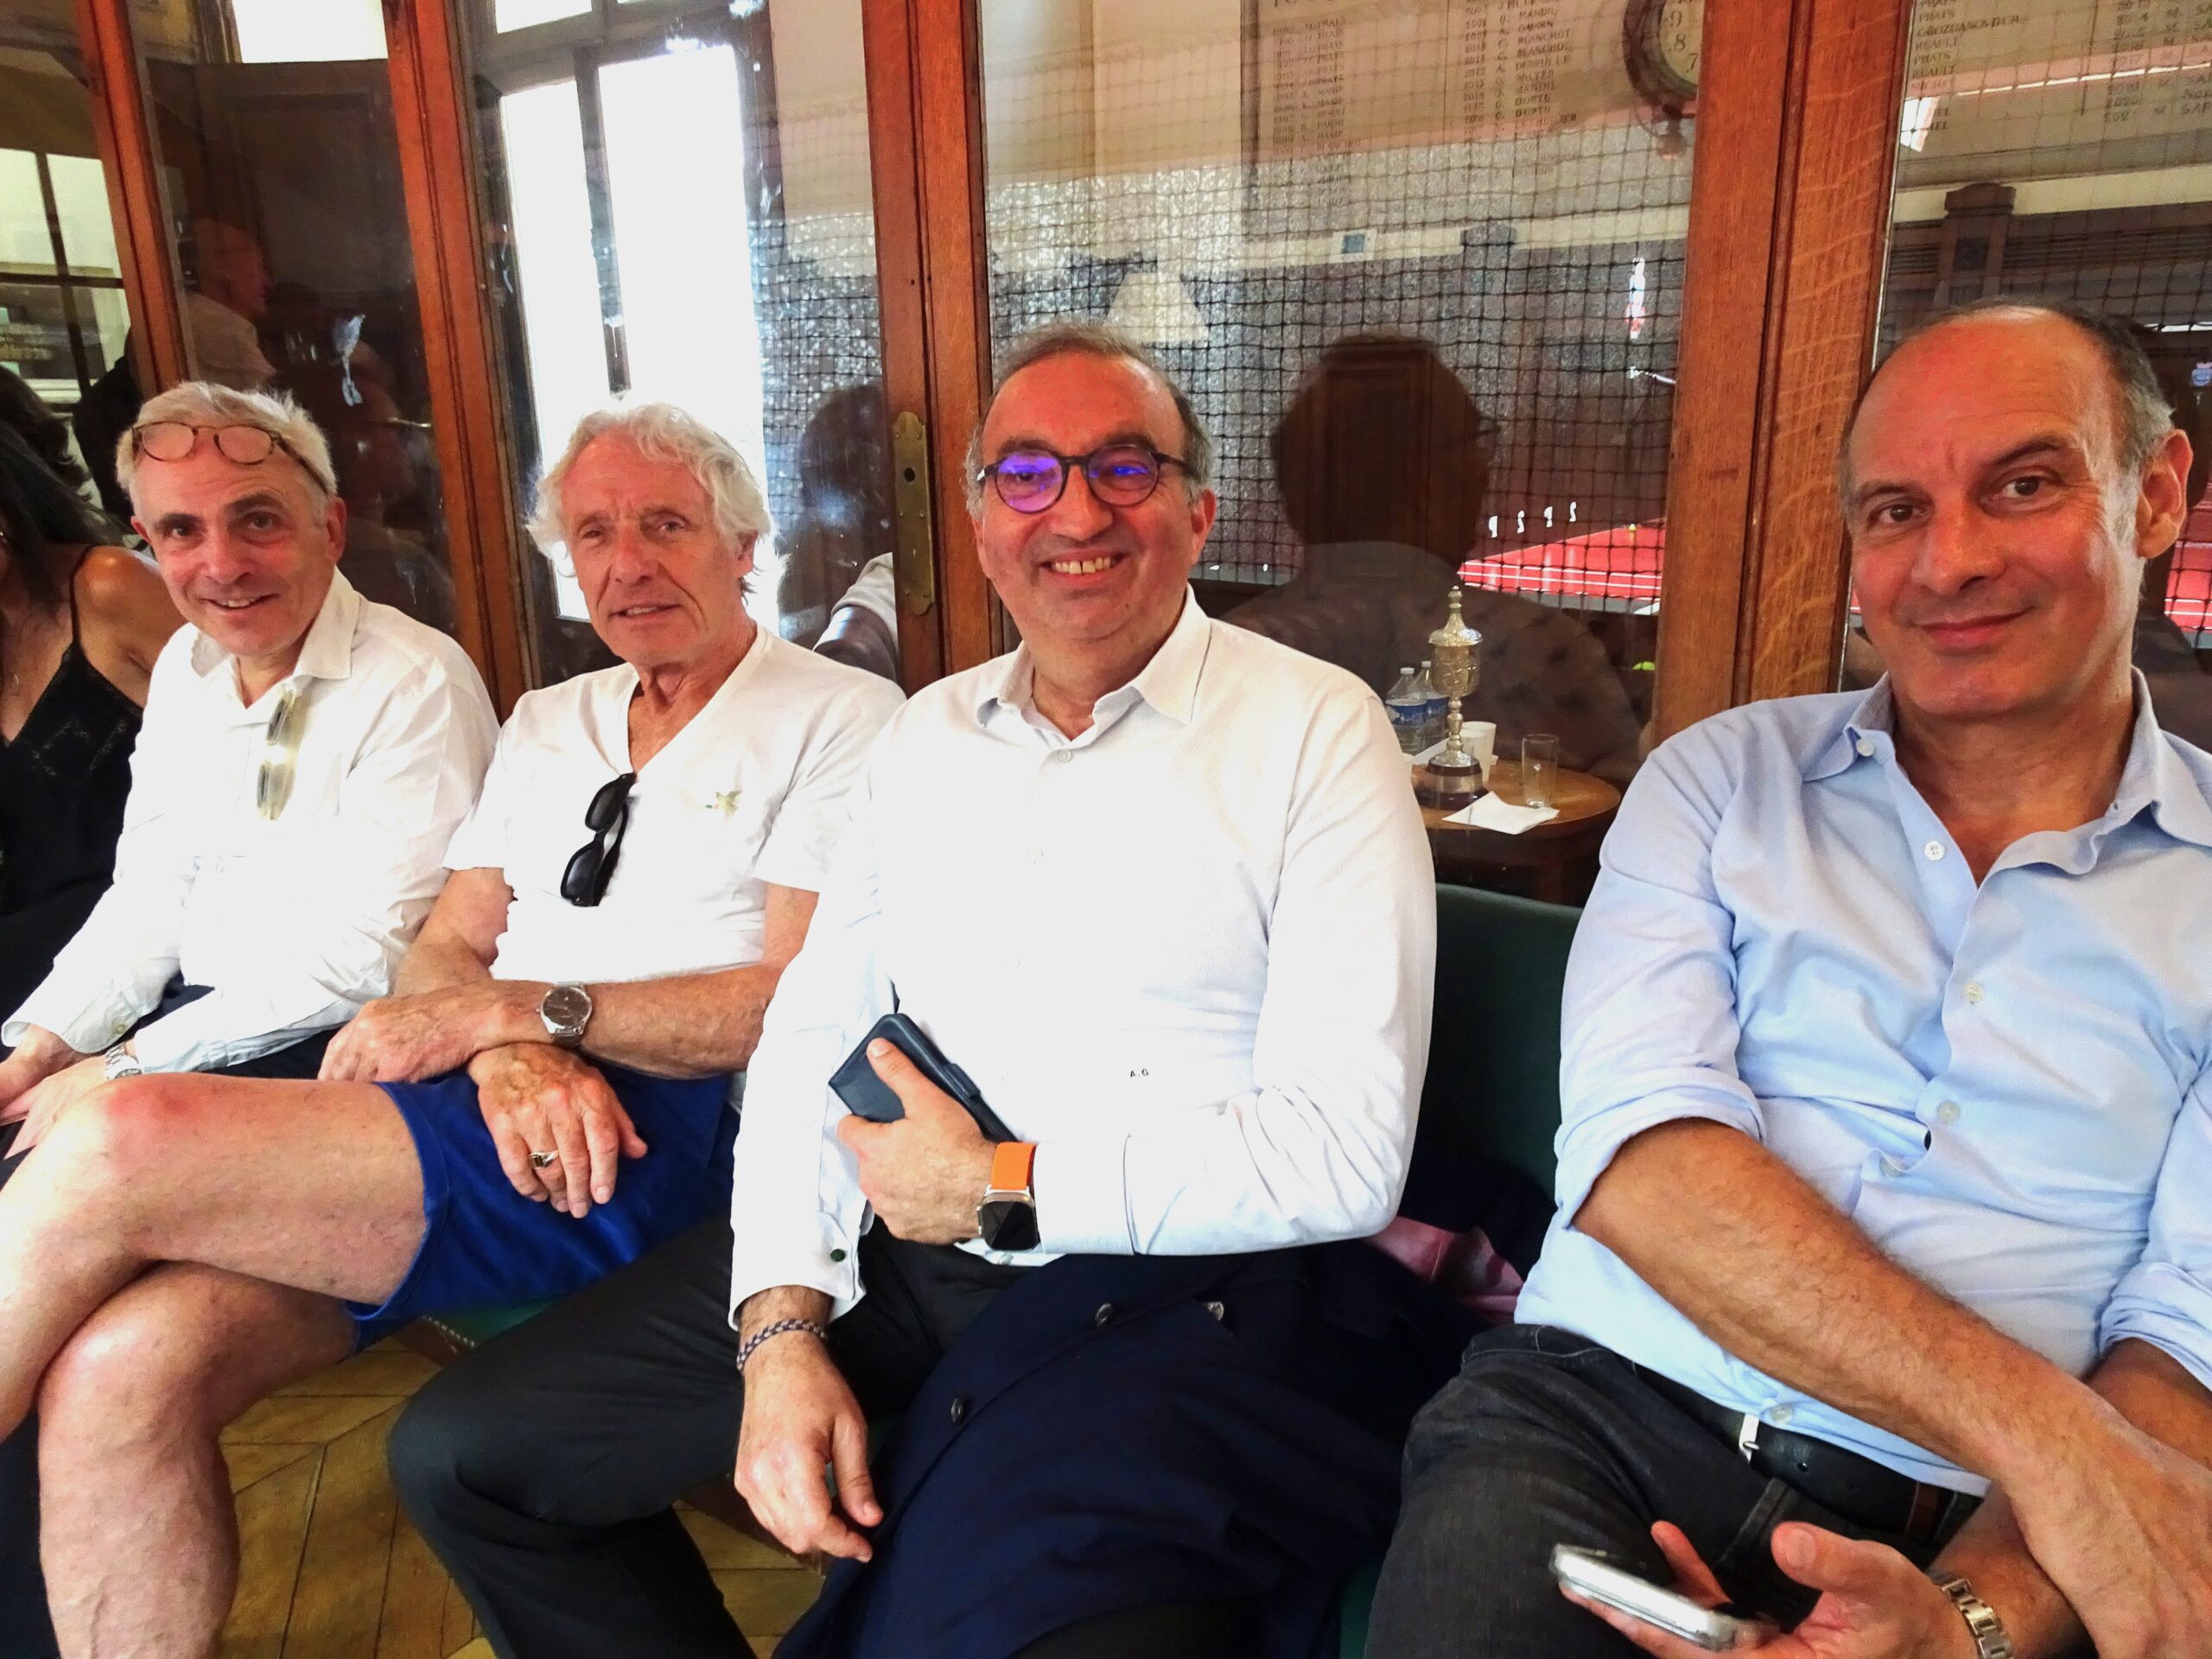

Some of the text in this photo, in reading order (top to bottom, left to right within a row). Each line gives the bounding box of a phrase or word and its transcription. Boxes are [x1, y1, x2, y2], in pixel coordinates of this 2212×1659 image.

[1670, 10, 1682, 27] 9
[1674, 33, 1687, 51] 8
[1687, 52, 1699, 73] 7
